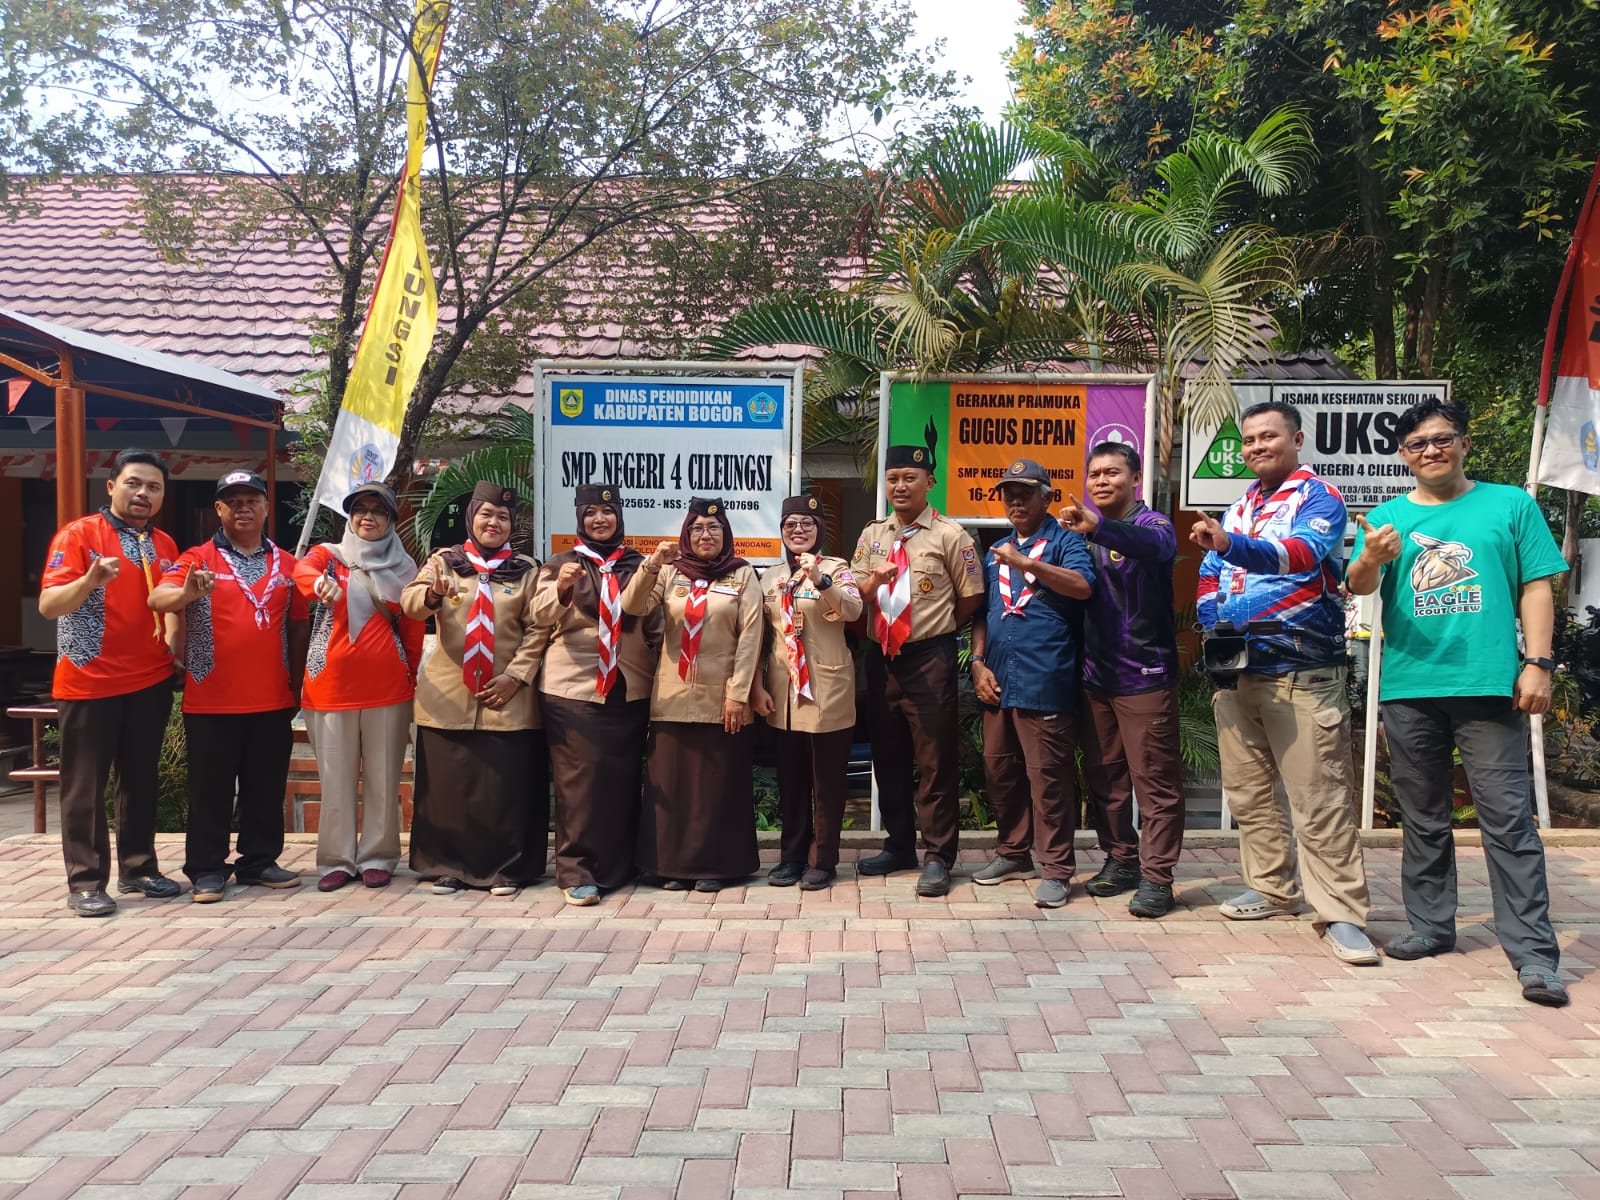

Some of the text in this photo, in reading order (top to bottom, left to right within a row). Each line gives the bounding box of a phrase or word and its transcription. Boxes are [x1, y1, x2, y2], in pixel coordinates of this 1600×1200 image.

[605, 389, 732, 405] DINAS PENDIDIKAN
[956, 393, 1081, 409] GERAKAN PRAMUKA
[1281, 392, 1319, 405] USAHA
[1322, 393, 1384, 405] KESEHATAN
[594, 404, 743, 422] KABUPATEN BOGOR
[959, 418, 1076, 446] GUGUS DEPAN
[1315, 411, 1400, 455] UKS
[561, 451, 773, 491] SMP NEGERI 4 CILEUNGSI
[957, 467, 979, 478] SMP
[1312, 463, 1354, 477] NEGERI
[1357, 464, 1365, 477] 4
[619, 499, 655, 509] 925652
[735, 541, 772, 549] ANDOANG
[1414, 592, 1480, 607] EAGLE
[1414, 605, 1480, 616] SCOUT CREW
